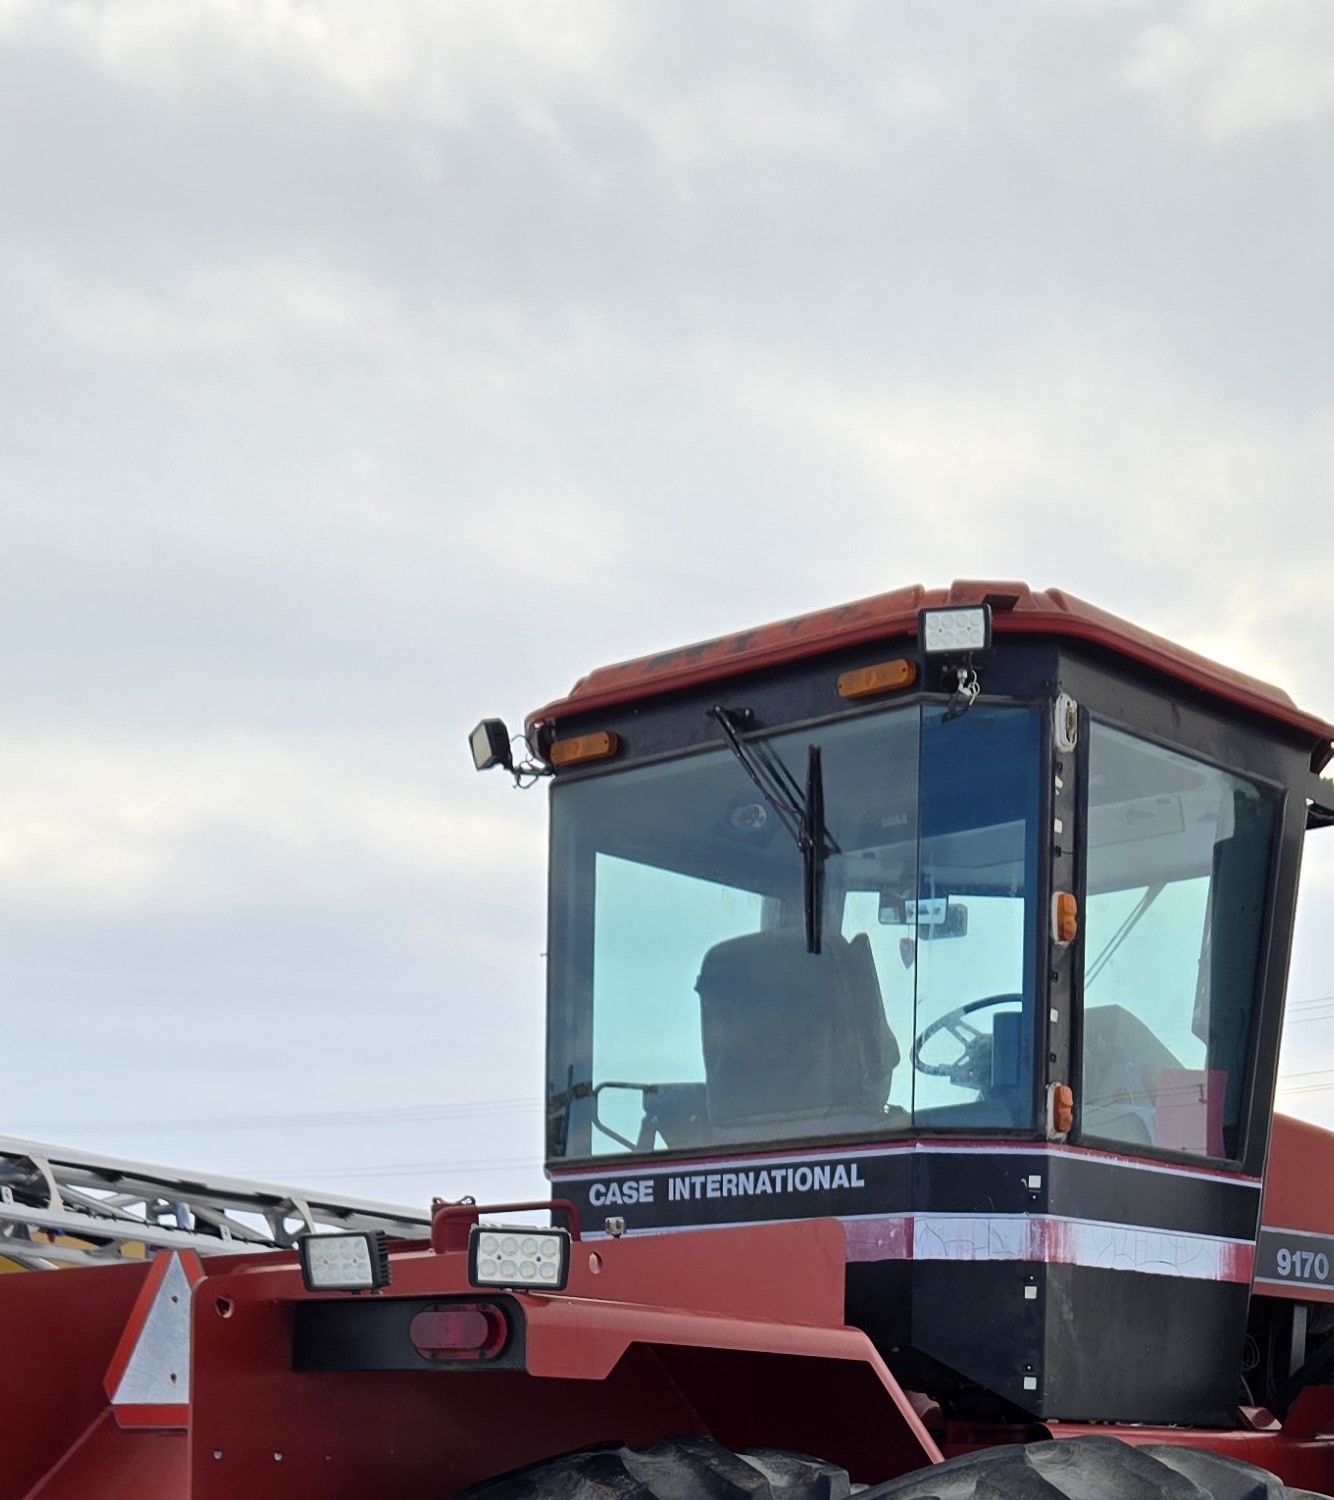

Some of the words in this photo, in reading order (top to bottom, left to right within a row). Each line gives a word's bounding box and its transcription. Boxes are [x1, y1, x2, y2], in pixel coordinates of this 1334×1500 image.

[589, 1177, 654, 1207] CASE
[668, 1163, 865, 1201] INTERNATIONAL
[1276, 1248, 1329, 1281] 9170
